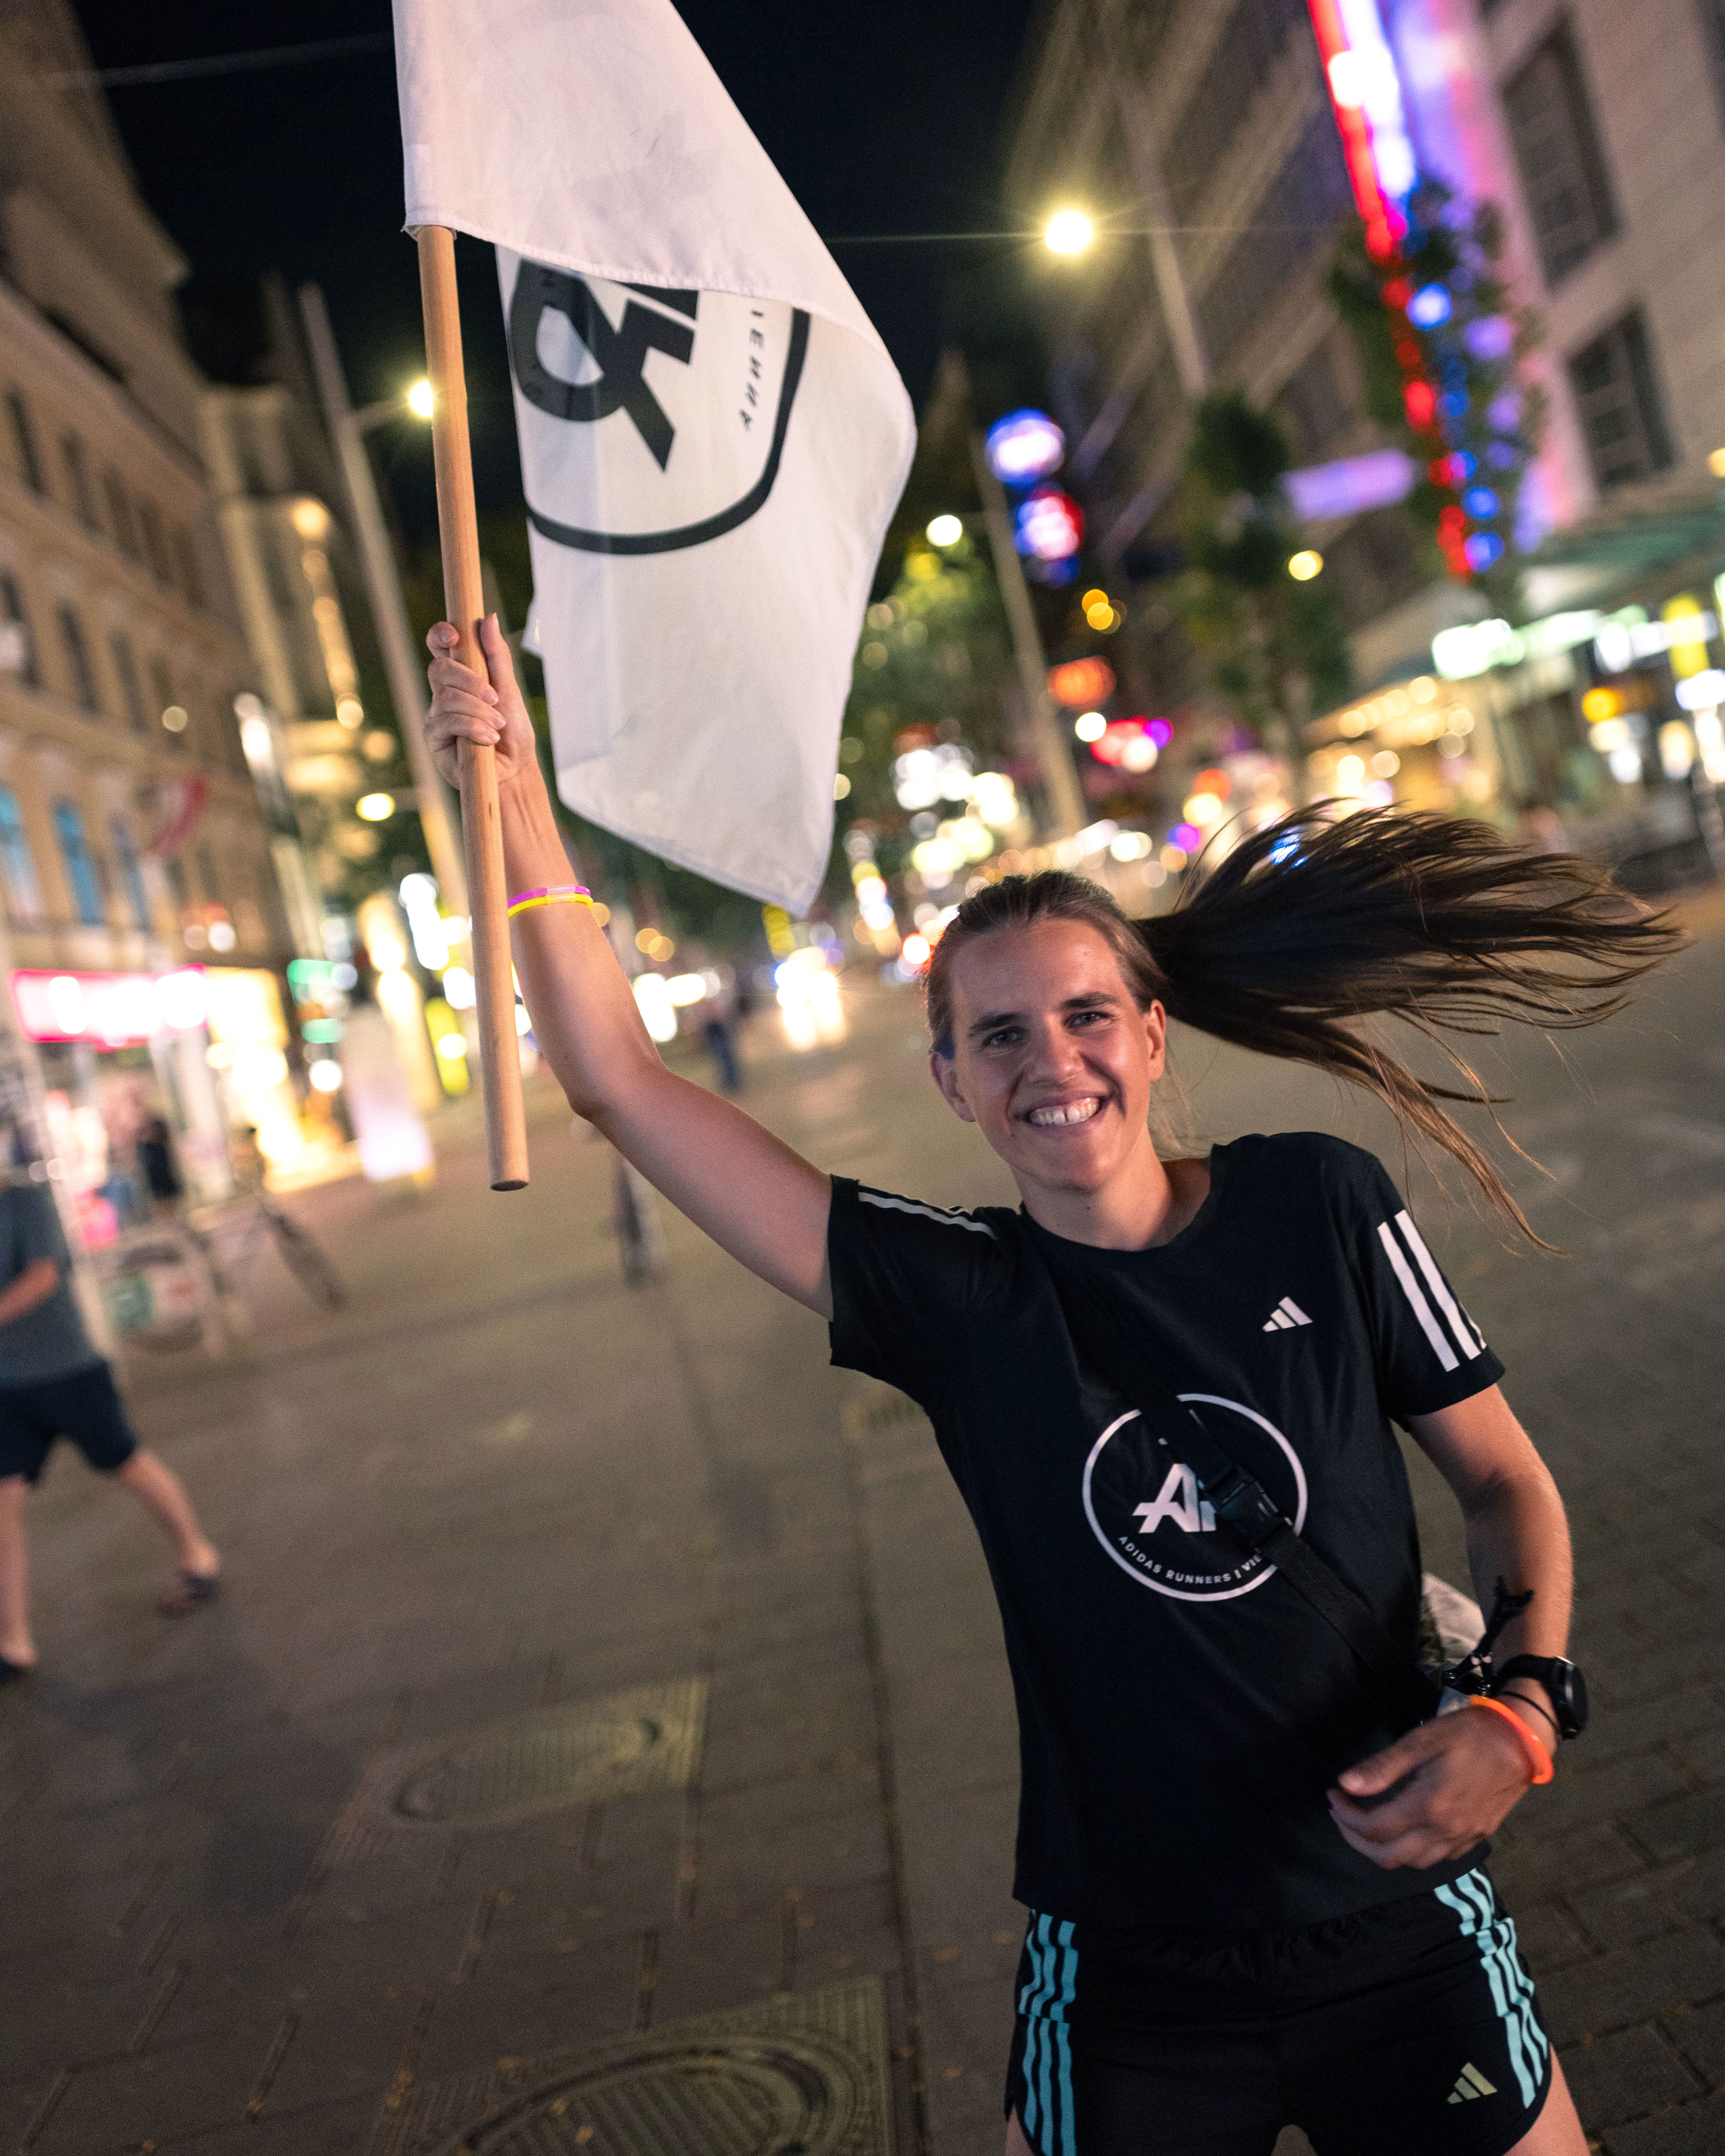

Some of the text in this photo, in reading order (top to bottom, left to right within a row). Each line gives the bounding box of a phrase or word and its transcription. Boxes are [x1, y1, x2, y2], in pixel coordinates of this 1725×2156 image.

[1118, 1536, 1162, 1573] ADIDAS
[1165, 1570, 1231, 1584] RUNNERS
[1241, 1554, 1262, 1571] VIE
